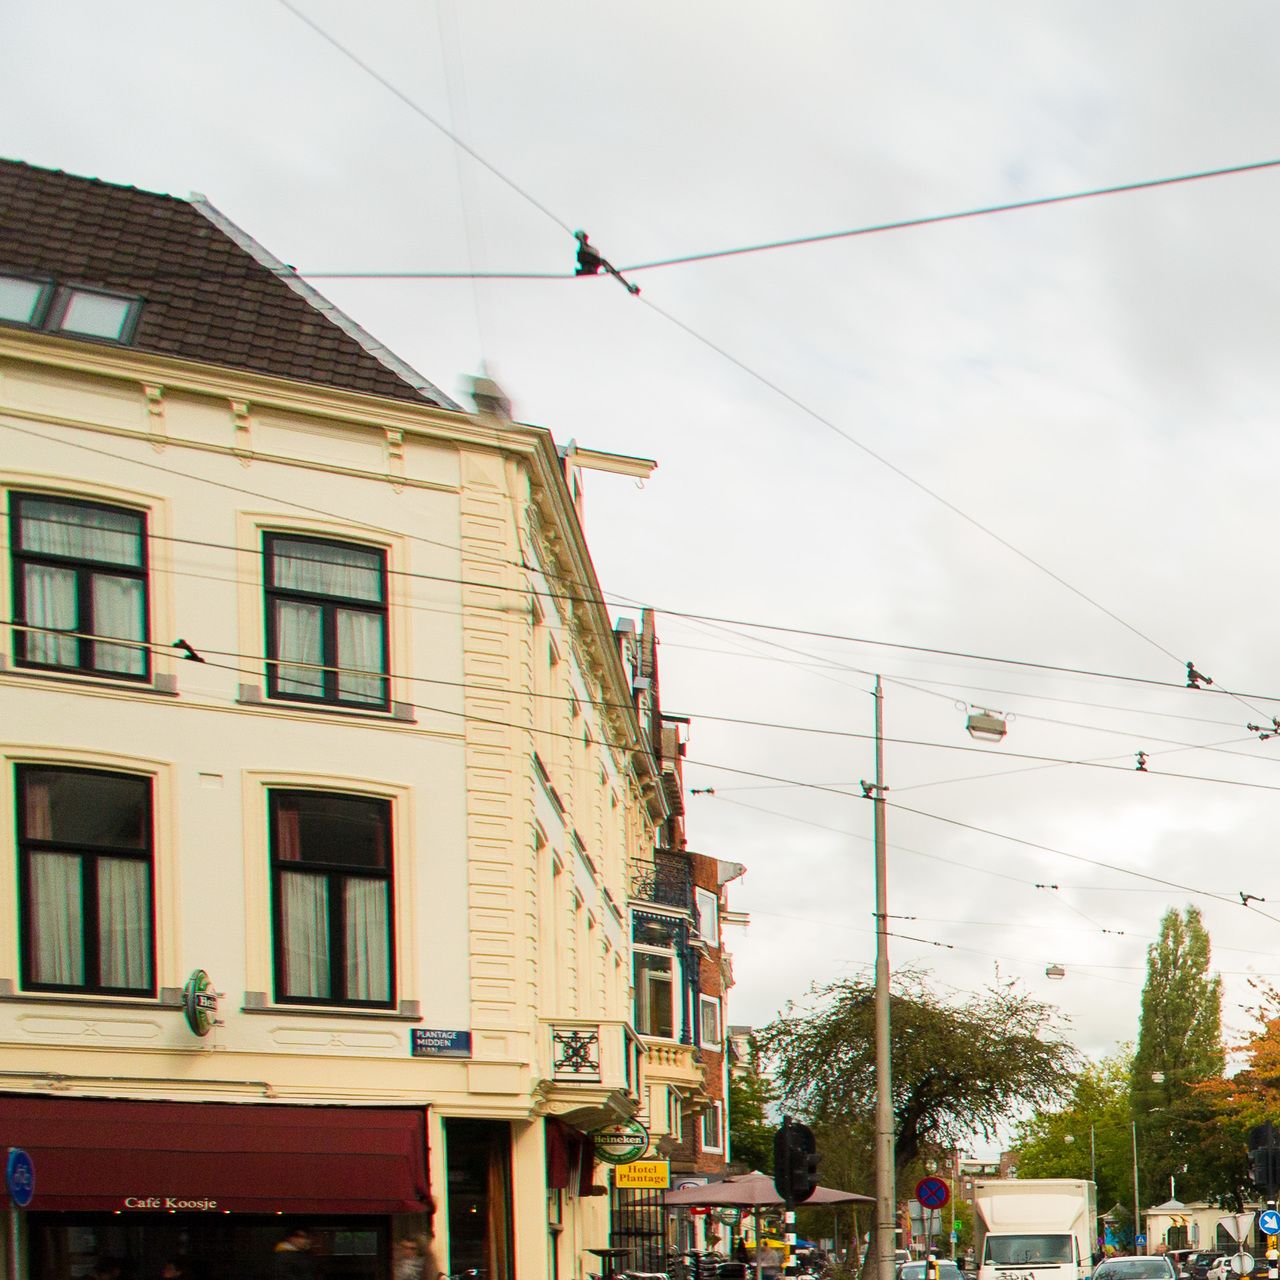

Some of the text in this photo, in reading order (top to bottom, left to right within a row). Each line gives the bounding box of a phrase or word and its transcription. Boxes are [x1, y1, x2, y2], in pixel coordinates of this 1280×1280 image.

[416, 1031, 457, 1039] PLANTAGE
[416, 1039, 452, 1047] MIDDEN
[594, 1135, 642, 1144] Heineken
[628, 1165, 657, 1173] Hotel
[619, 1174, 666, 1183] Plantage
[124, 1197, 217, 1211] Café Koosje
